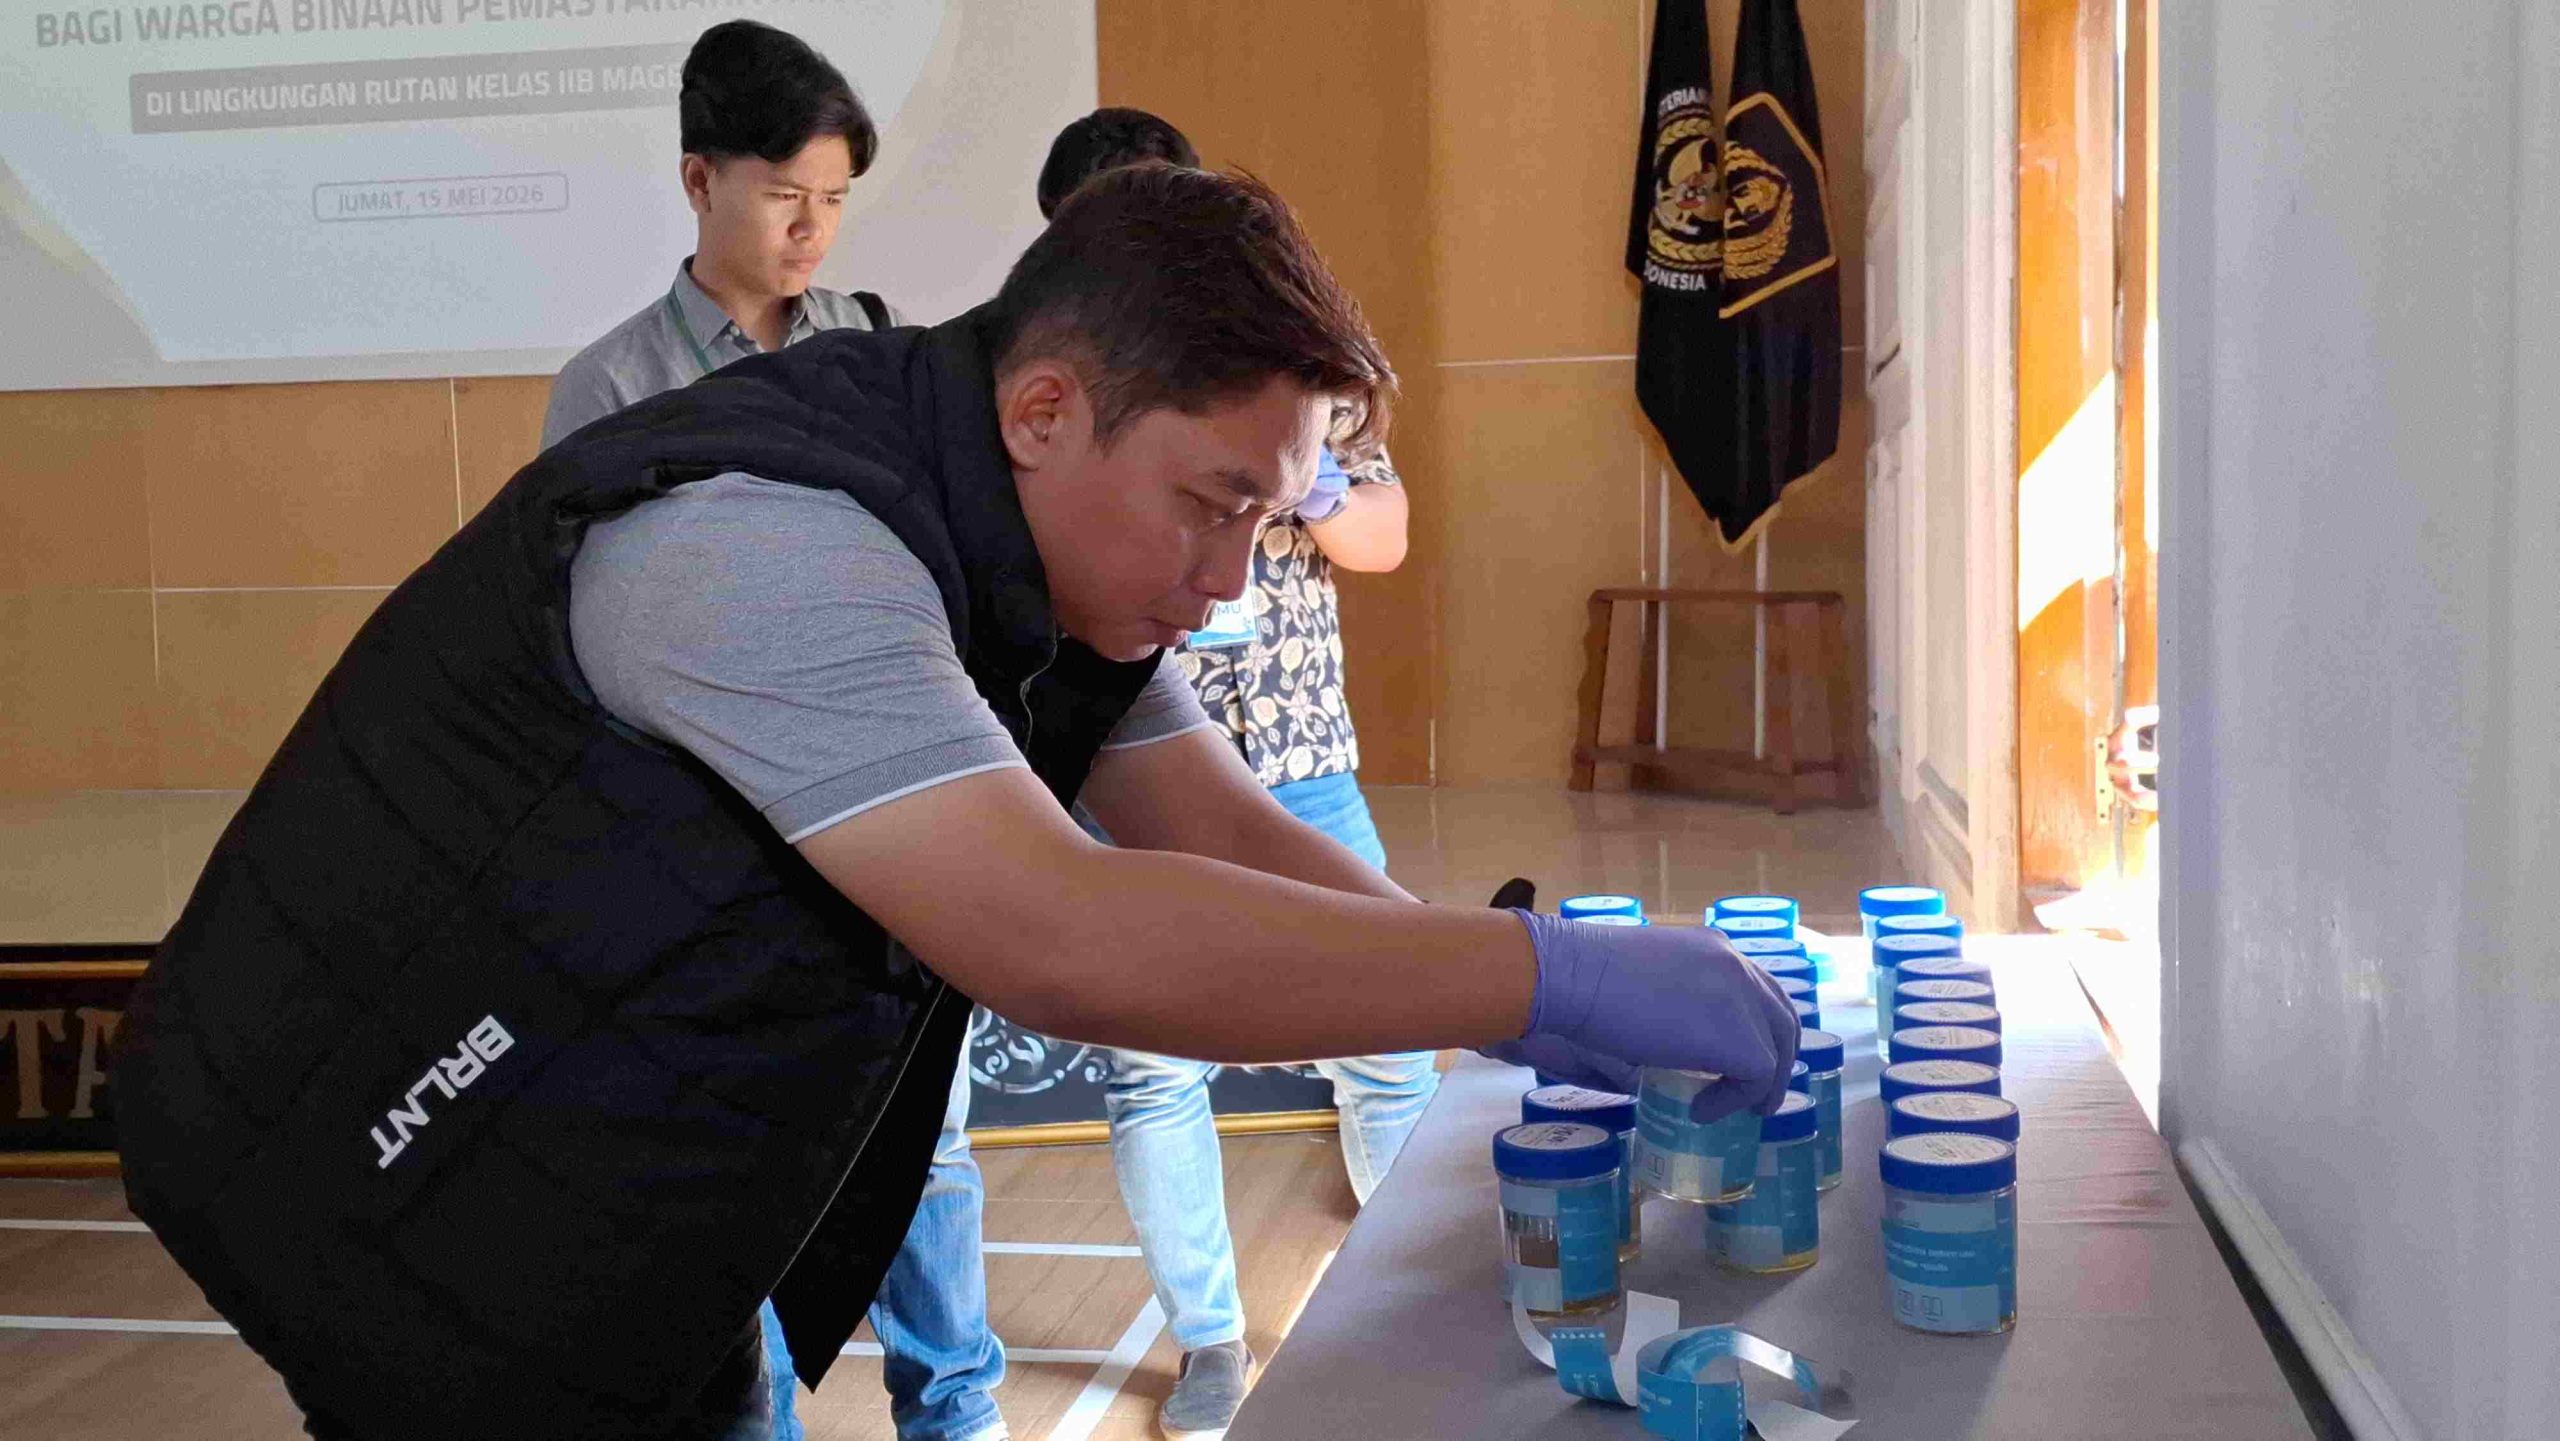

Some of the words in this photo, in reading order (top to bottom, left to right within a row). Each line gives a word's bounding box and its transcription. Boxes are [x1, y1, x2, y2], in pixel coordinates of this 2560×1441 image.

[36, 10, 123, 48] BAGI
[135, 0, 280, 42] WARGA
[293, 0, 443, 33] BINAAN
[146, 90, 172, 116] DI
[180, 81, 357, 116] LINGKUNGAN
[365, 75, 458, 107] RUTAN
[466, 70, 551, 99] KELAS
[558, 67, 594, 96] IIB
[338, 191, 410, 214] JUMAT,
[417, 189, 441, 208] 15
[449, 186, 487, 207] MEI
[492, 184, 544, 204] 2026
[370, 1014, 516, 1170] BRLNT
